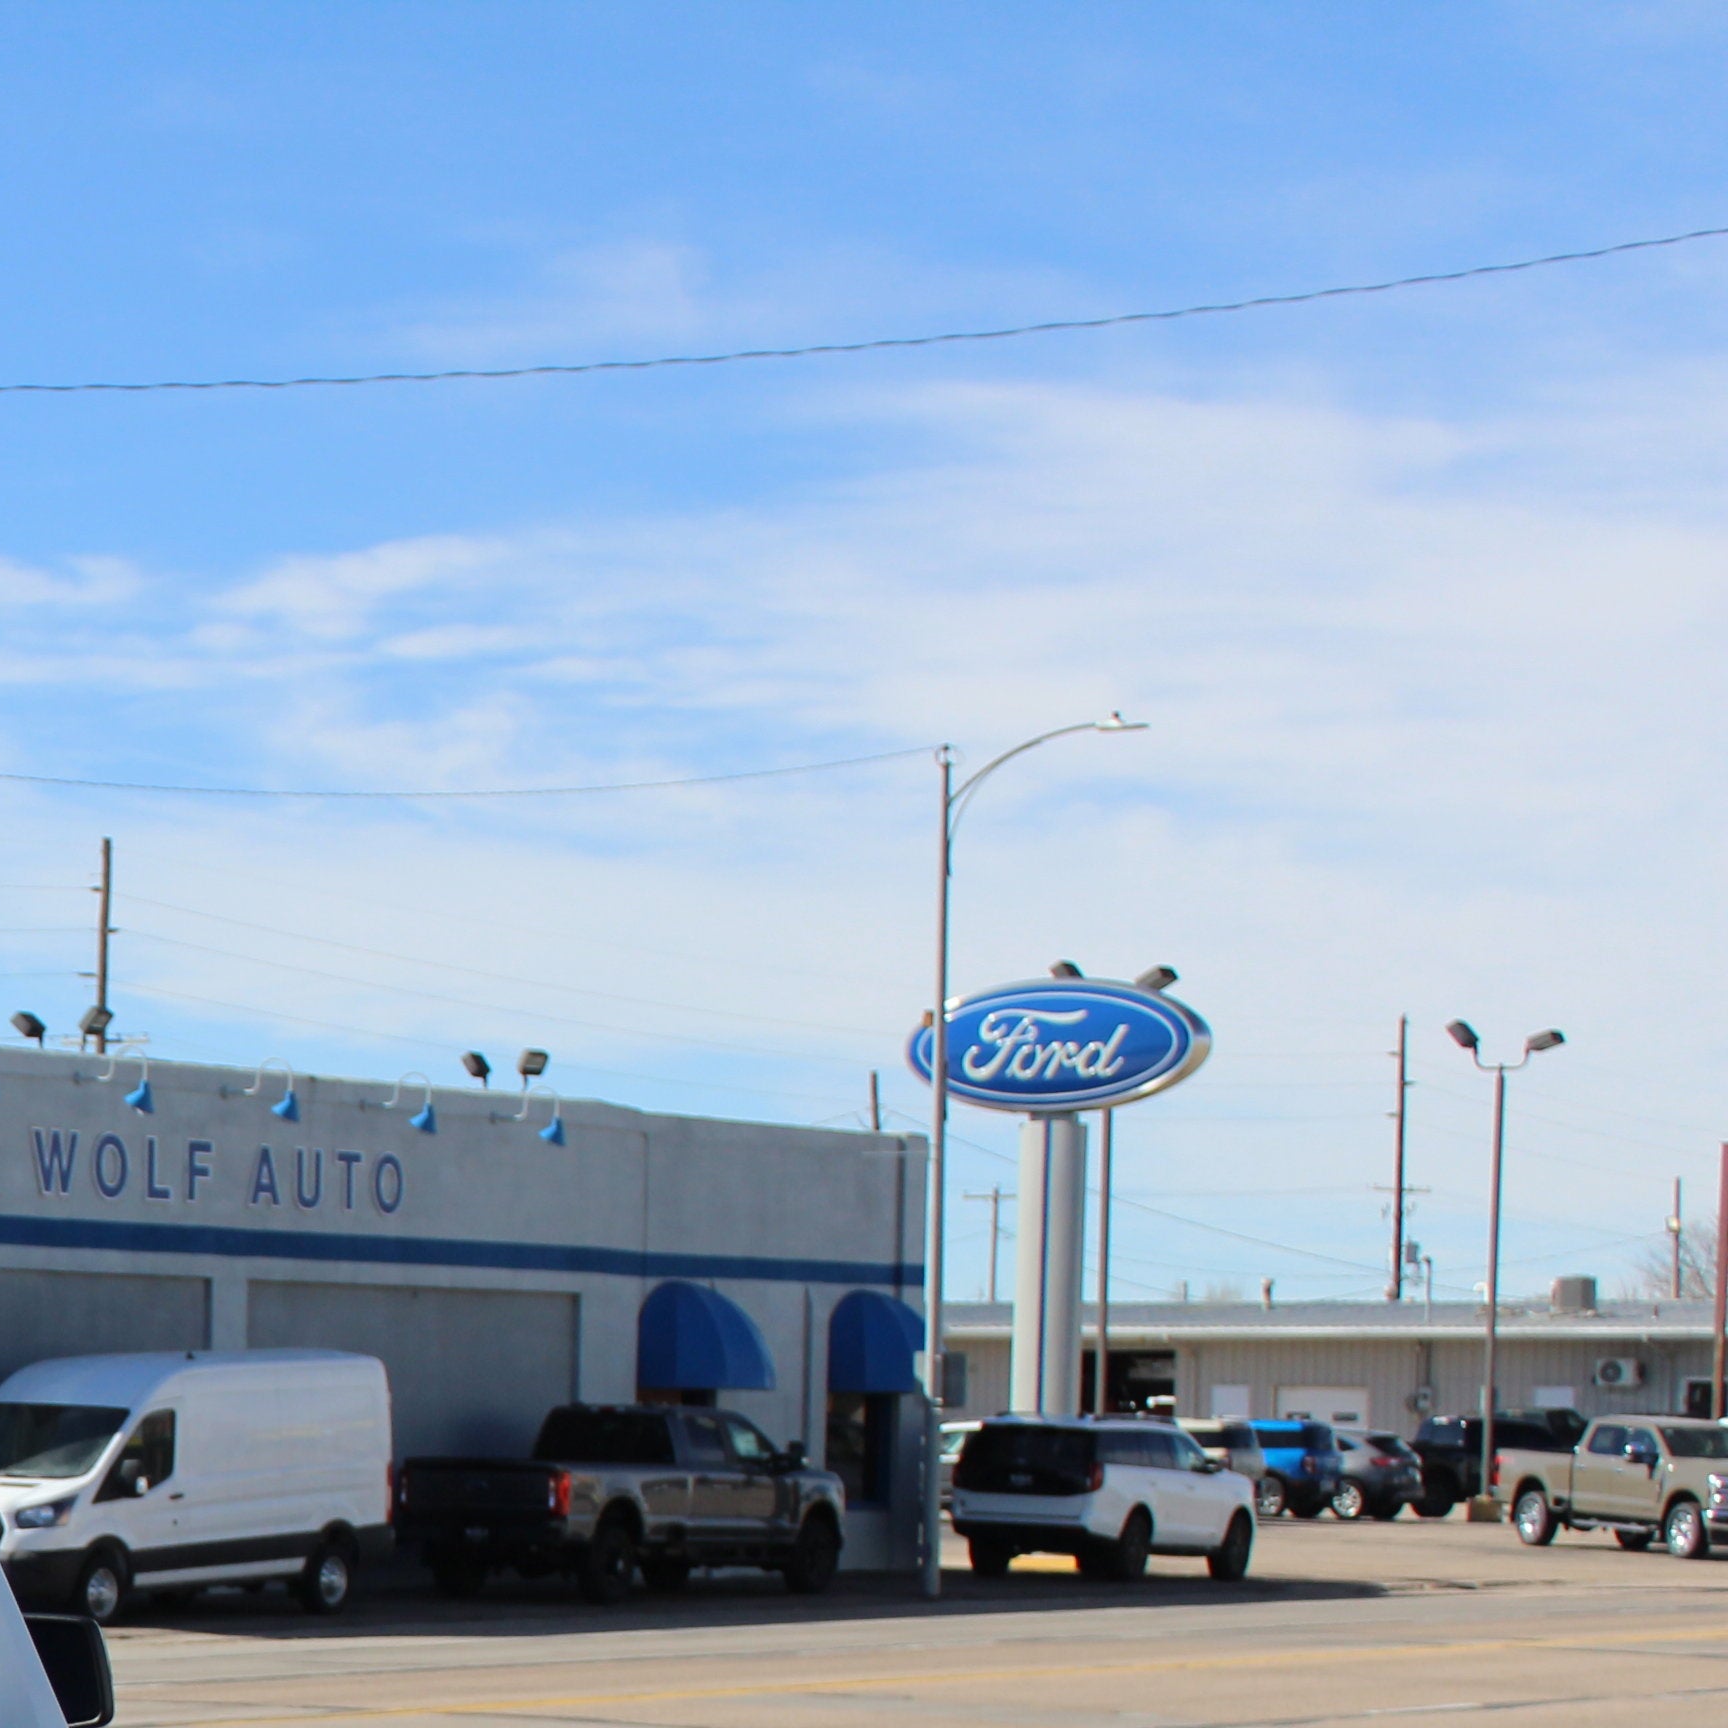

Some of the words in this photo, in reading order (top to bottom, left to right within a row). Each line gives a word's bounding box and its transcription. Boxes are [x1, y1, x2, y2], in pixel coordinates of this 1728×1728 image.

[962, 1008, 1130, 1082] Ford
[32, 1126, 214, 1202] WOLF
[249, 1142, 405, 1215] AUTO
